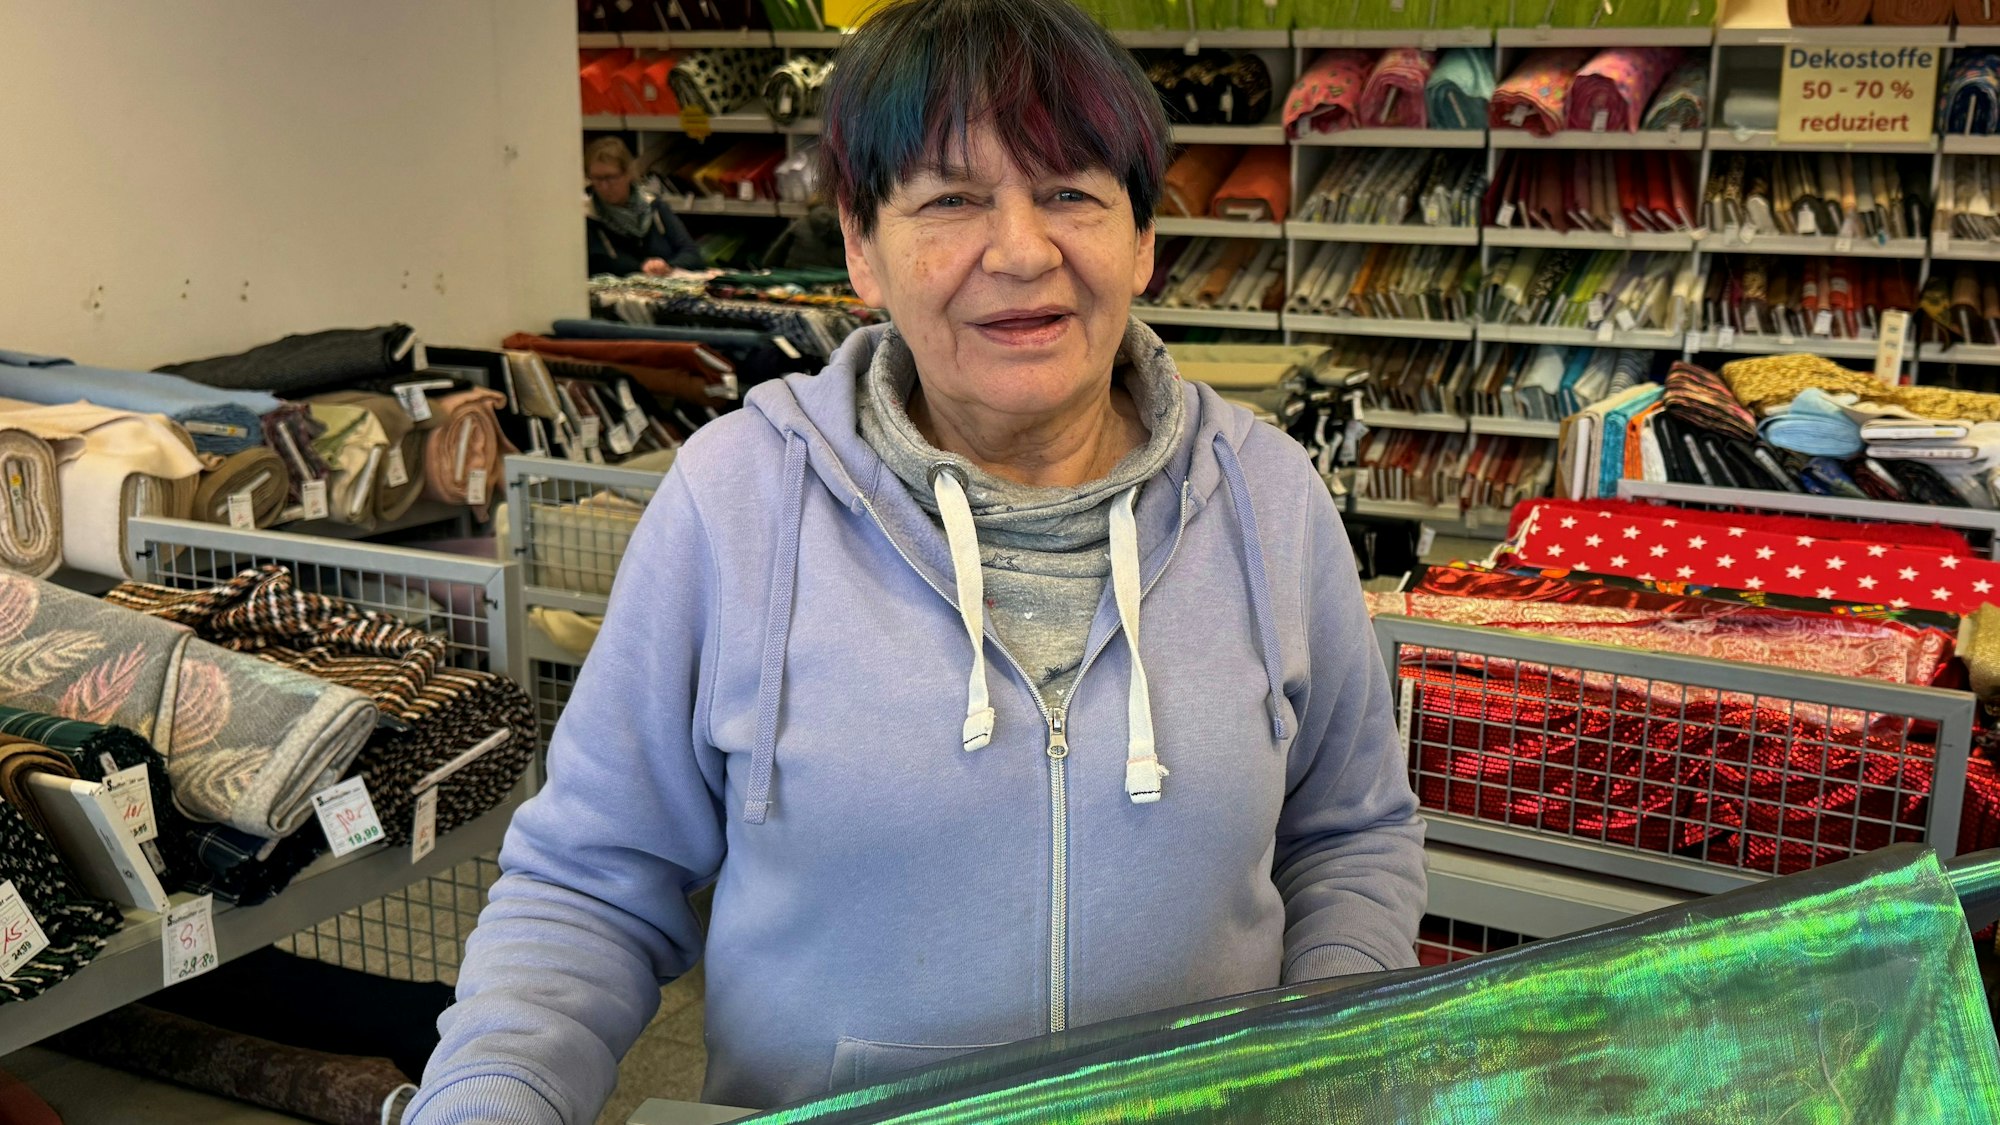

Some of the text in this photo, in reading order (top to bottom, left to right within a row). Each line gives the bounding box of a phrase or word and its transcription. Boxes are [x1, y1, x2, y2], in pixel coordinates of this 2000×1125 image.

[1790, 48, 1932, 69] Dekostoffe
[1802, 80, 1832, 99] 50
[1855, 80, 1884, 99] 70
[1890, 81, 1914, 100] %
[1800, 111, 1910, 132] reduziert
[348, 825, 379, 846] 19,99
